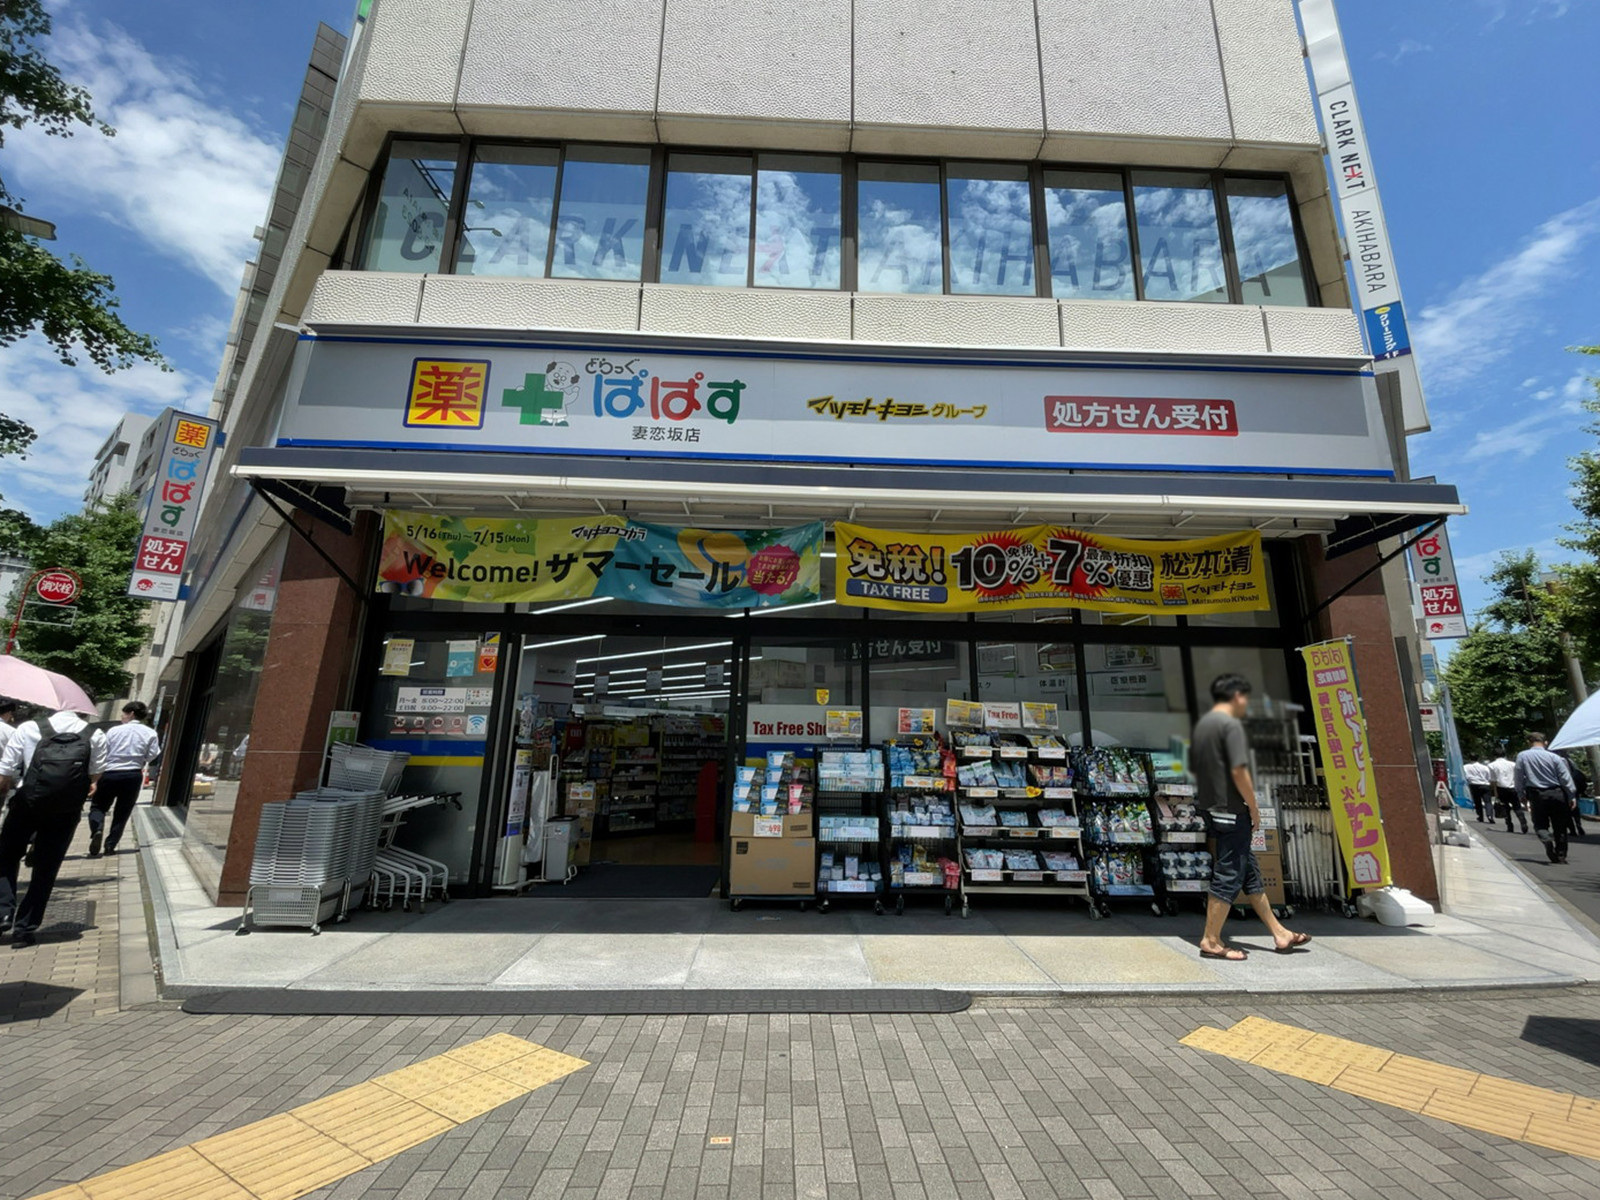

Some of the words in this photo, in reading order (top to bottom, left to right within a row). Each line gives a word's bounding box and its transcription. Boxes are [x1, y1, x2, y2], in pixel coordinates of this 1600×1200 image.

[1329, 100, 1357, 149] CLARK
[1341, 152, 1366, 189] NEXT
[1351, 210, 1387, 294] AKIHABARA
[585, 357, 641, 375] どらっぐ
[414, 364, 481, 422] 薬
[594, 368, 747, 425] ぱぱす
[807, 395, 988, 421] マツモトキヨシグループ
[1052, 401, 1230, 432] 処方せん受付
[178, 422, 207, 447] 薬
[631, 425, 701, 443] 妻恋坂店
[145, 538, 184, 557] 処方
[1416, 523, 1442, 576] ぱす
[143, 554, 179, 572] せん
[404, 550, 539, 584] Welcome!
[545, 550, 741, 593] サマーセール
[1160, 545, 1254, 579] 松本清
[40, 581, 72, 595] 消火栓
[860, 581, 889, 597] TAX
[893, 586, 930, 601] FREE
[1186, 581, 1257, 595] マツモトキヨシ
[1422, 587, 1455, 601] 処方
[1425, 601, 1458, 615] せん
[1039, 679, 1066, 688] 体温計
[753, 721, 774, 735] Tax
[777, 721, 804, 735] Free
